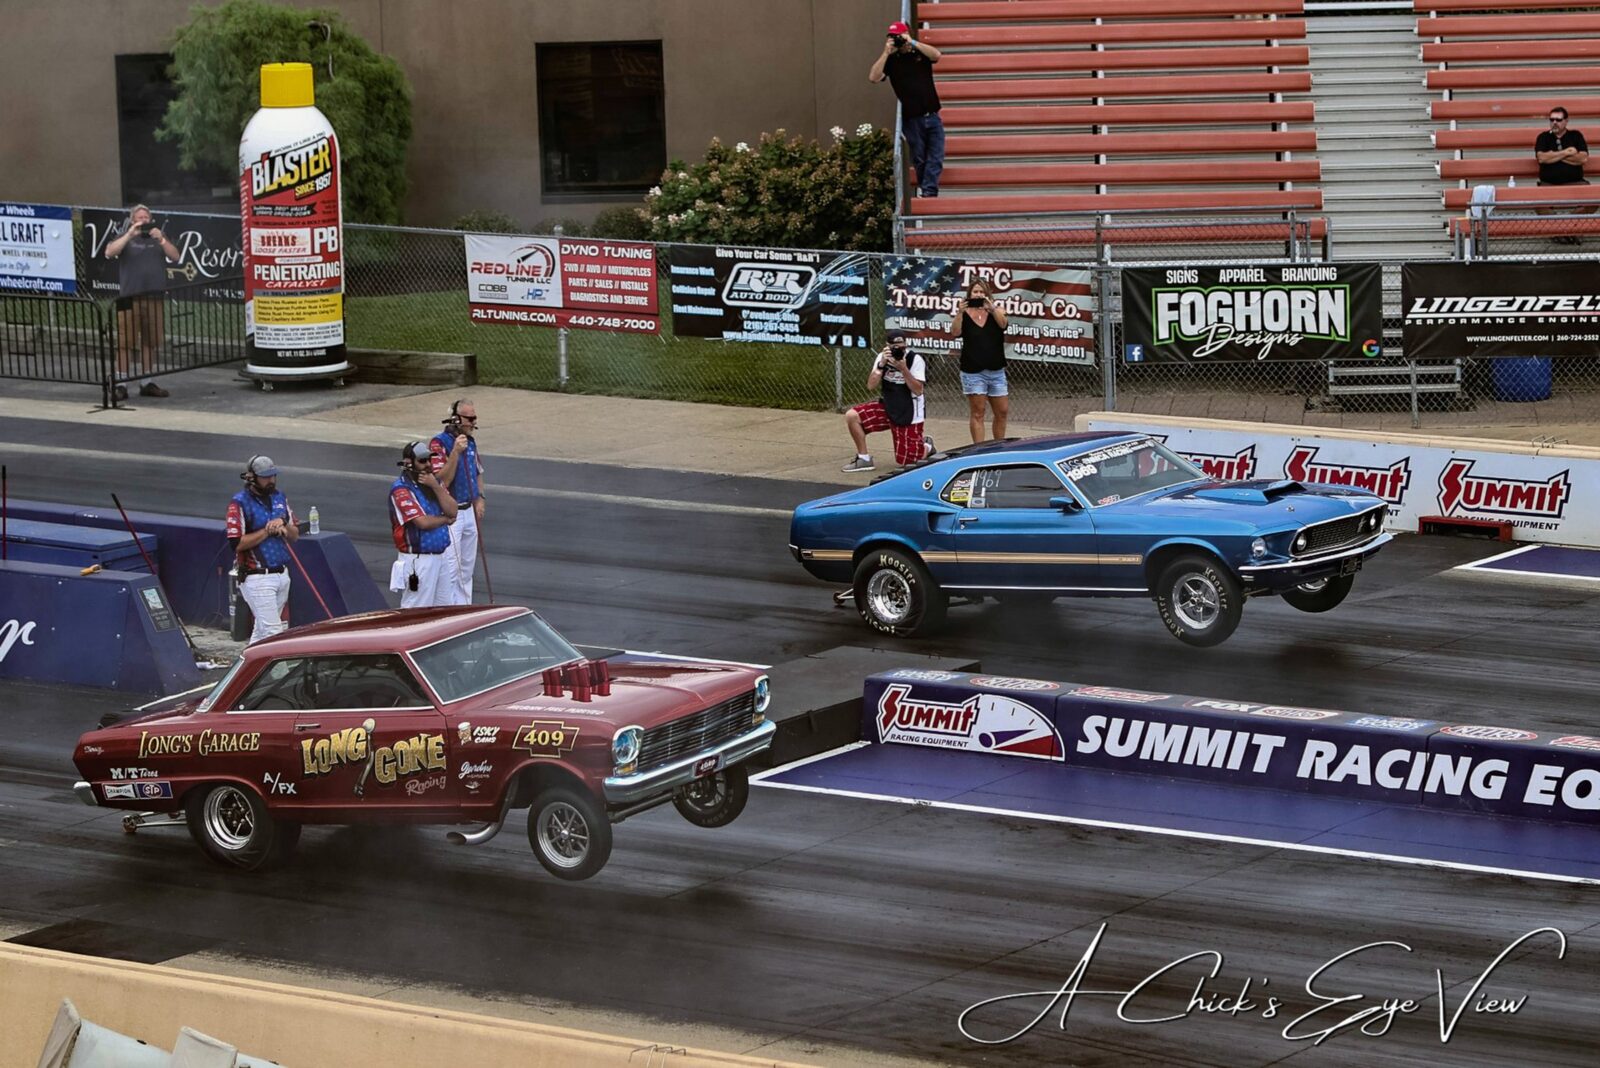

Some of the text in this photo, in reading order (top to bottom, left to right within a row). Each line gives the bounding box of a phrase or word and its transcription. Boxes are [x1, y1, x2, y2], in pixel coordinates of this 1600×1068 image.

[295, 171, 331, 196] SINCE 1957
[6, 204, 35, 216] Wheels
[10, 222, 45, 244] CRAFT
[260, 235, 297, 247] BREAKS
[313, 226, 338, 254] PB
[561, 244, 653, 260] DYNO TUNING
[715, 248, 734, 258] Give
[734, 248, 753, 260] Your
[753, 249, 768, 260] Car
[769, 250, 792, 261] Some
[254, 261, 340, 281] PENETRATING
[958, 265, 1011, 290] TFC
[1166, 267, 1337, 284] SIGNS APPAREL BRANDING
[265, 279, 327, 288] CATALYST
[506, 275, 535, 284] TUNING
[568, 277, 587, 288] PARTS
[595, 279, 613, 290] SALES
[621, 280, 649, 292] INSTALLS
[731, 269, 804, 295] R&R
[570, 291, 648, 306] DIAGNOSTICS AND SERVICE
[729, 291, 797, 303] AUTO BODY
[1051, 298, 1082, 318] Co.
[1156, 289, 1346, 341] FOGHORN
[472, 309, 556, 324] RLTUNING.COM
[568, 315, 656, 331] 440-748-7000
[1405, 316, 1526, 326] PERFORMANCE
[929, 320, 941, 330] us
[1003, 324, 1083, 339] elivery Service"
[1192, 322, 1304, 360] Designs
[1466, 334, 1549, 343] WWW.LINGENFELTER.COM
[1556, 334, 1600, 342] 260-724-2552
[1067, 464, 1098, 482] 1969
[1440, 462, 1565, 514] SUMMIT
[879, 554, 916, 585] Hoosier
[1203, 566, 1228, 610] Hoosier
[882, 688, 976, 735] SUMMIT
[1192, 700, 1255, 712] FOX
[473, 726, 501, 737] ISKY
[523, 730, 564, 747] 409
[138, 728, 261, 759] LONG'S GARAGE
[474, 736, 497, 744] CAMS
[890, 733, 969, 749] RACING EQUIPMENT
[302, 727, 367, 776] LONG
[374, 733, 447, 785] GONE
[1076, 715, 1286, 776] SUMMIT
[1296, 740, 1510, 801] RACING
[110, 767, 159, 780] M/T Tires
[106, 787, 132, 796] CHAMPION
[145, 784, 160, 797] STP
[263, 772, 297, 795] A/FX
[405, 775, 447, 797] Racing
